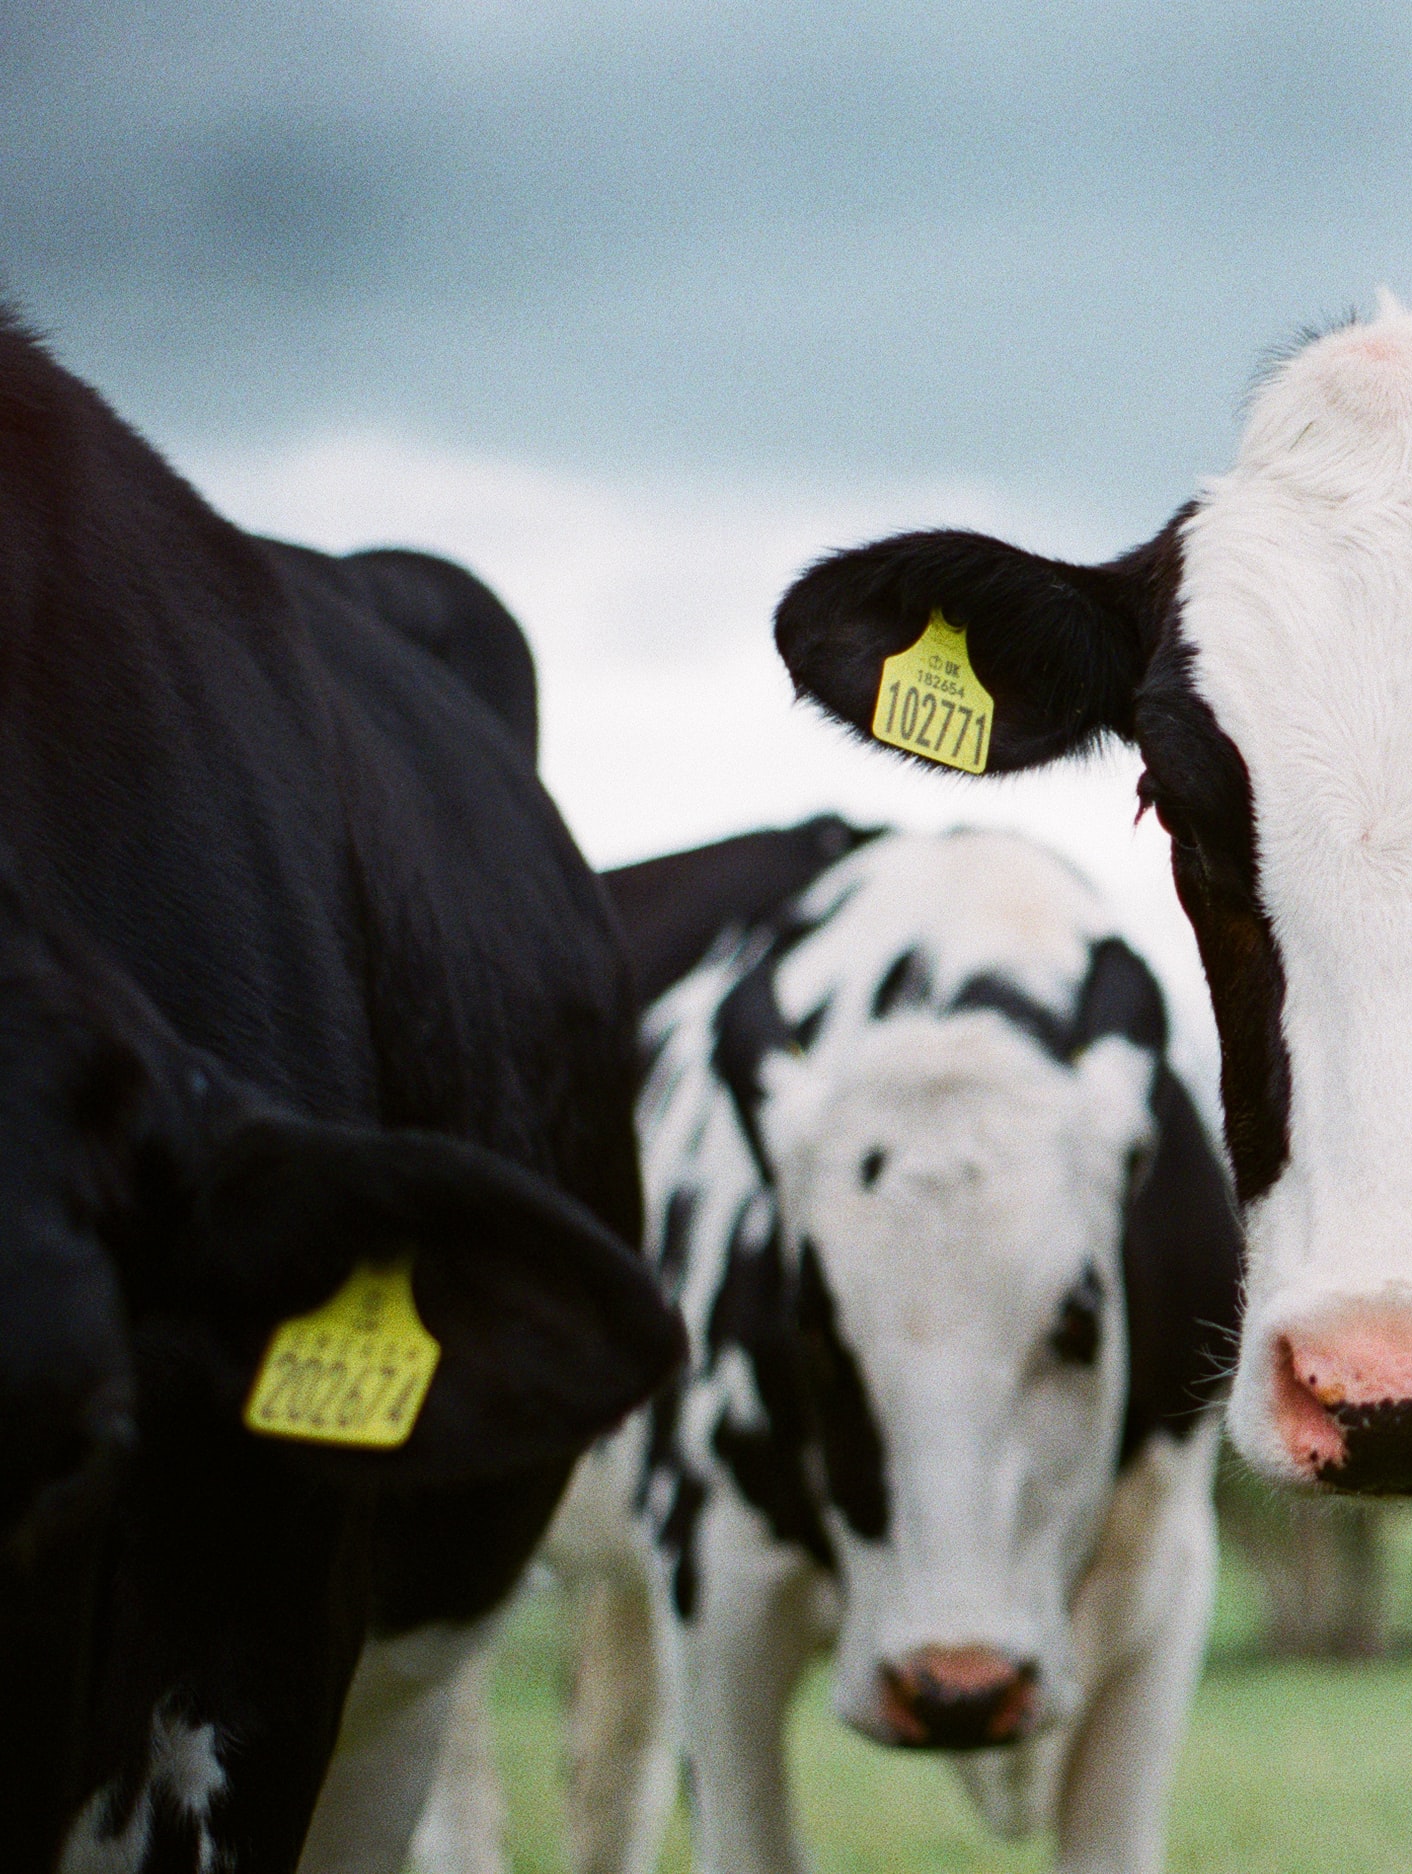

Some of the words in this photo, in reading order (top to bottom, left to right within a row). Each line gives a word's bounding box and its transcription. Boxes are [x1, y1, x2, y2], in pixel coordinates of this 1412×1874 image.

[918, 669, 965, 699] 182654
[945, 660, 961, 678] UK
[885, 679, 986, 765] 102771
